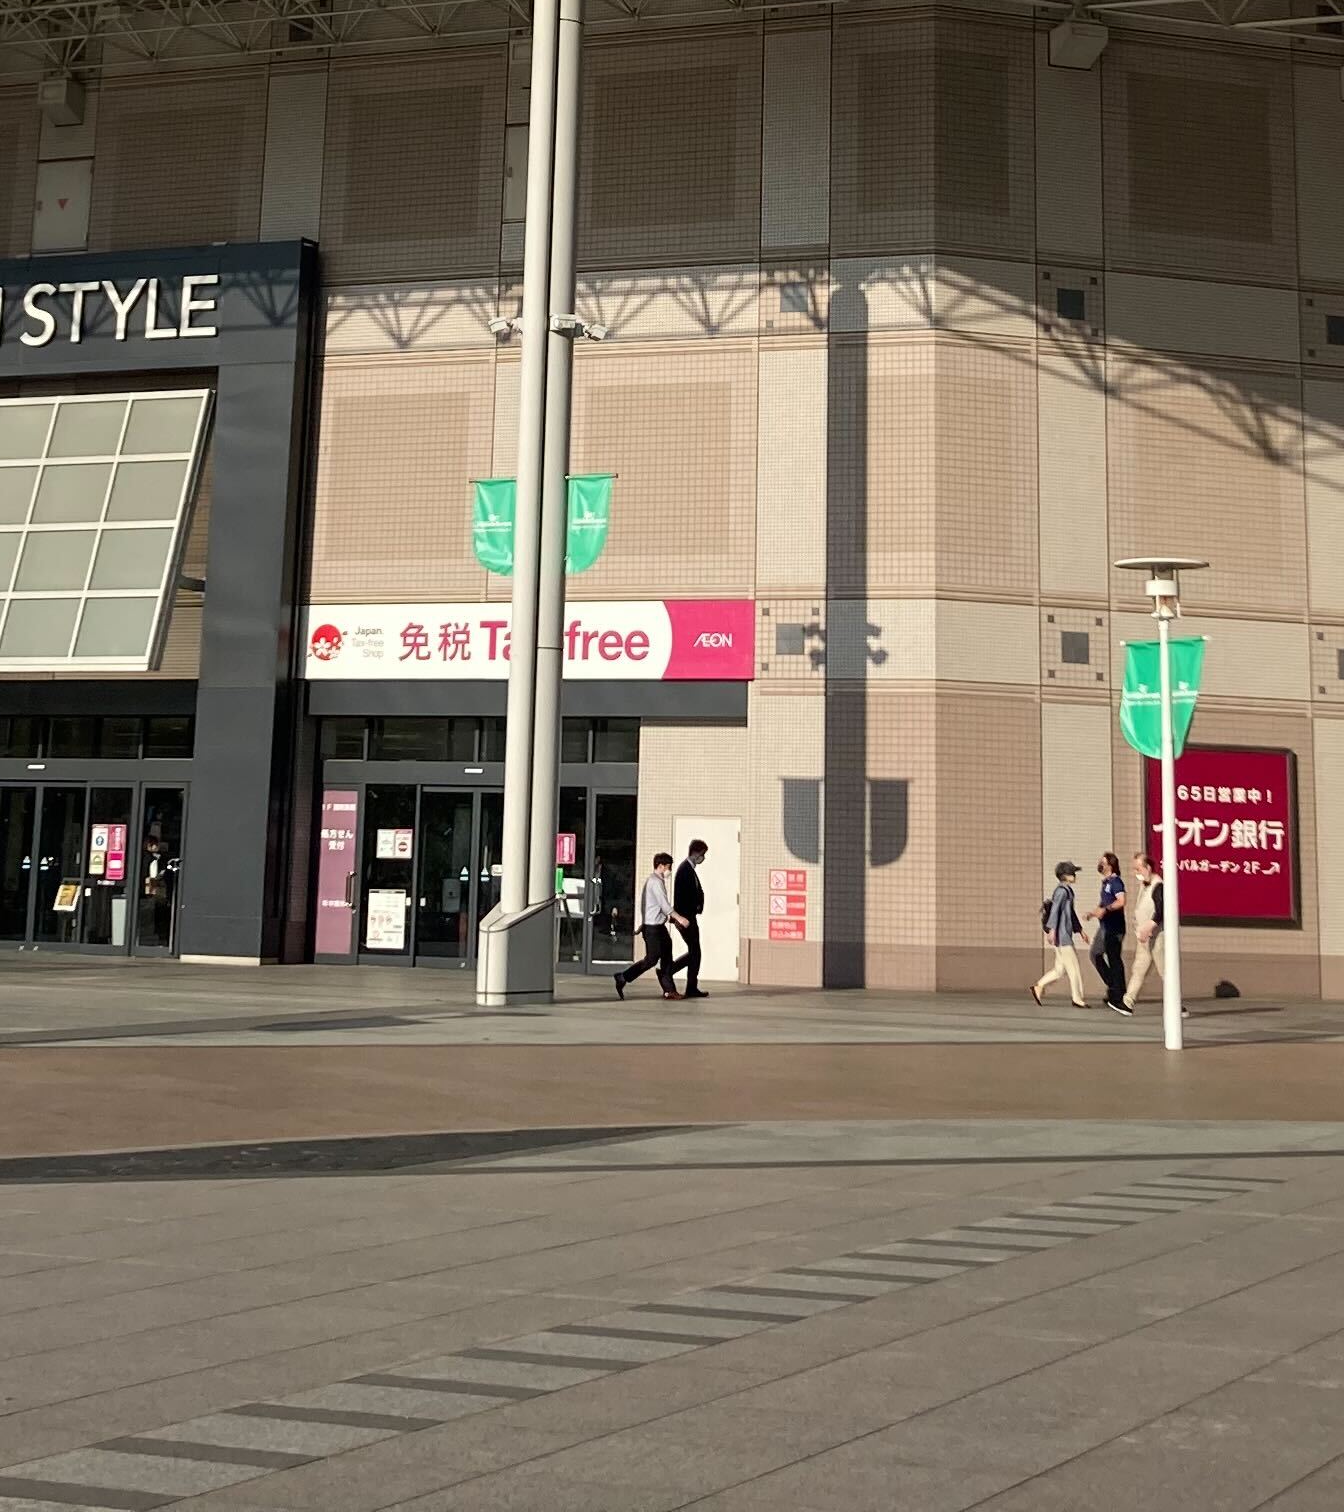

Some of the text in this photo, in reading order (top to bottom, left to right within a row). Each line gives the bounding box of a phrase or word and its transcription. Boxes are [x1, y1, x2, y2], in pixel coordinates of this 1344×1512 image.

[19, 274, 219, 347] STYLE
[398, 622, 471, 662] 免税
[1176, 784, 1273, 804] 65日営業中！
